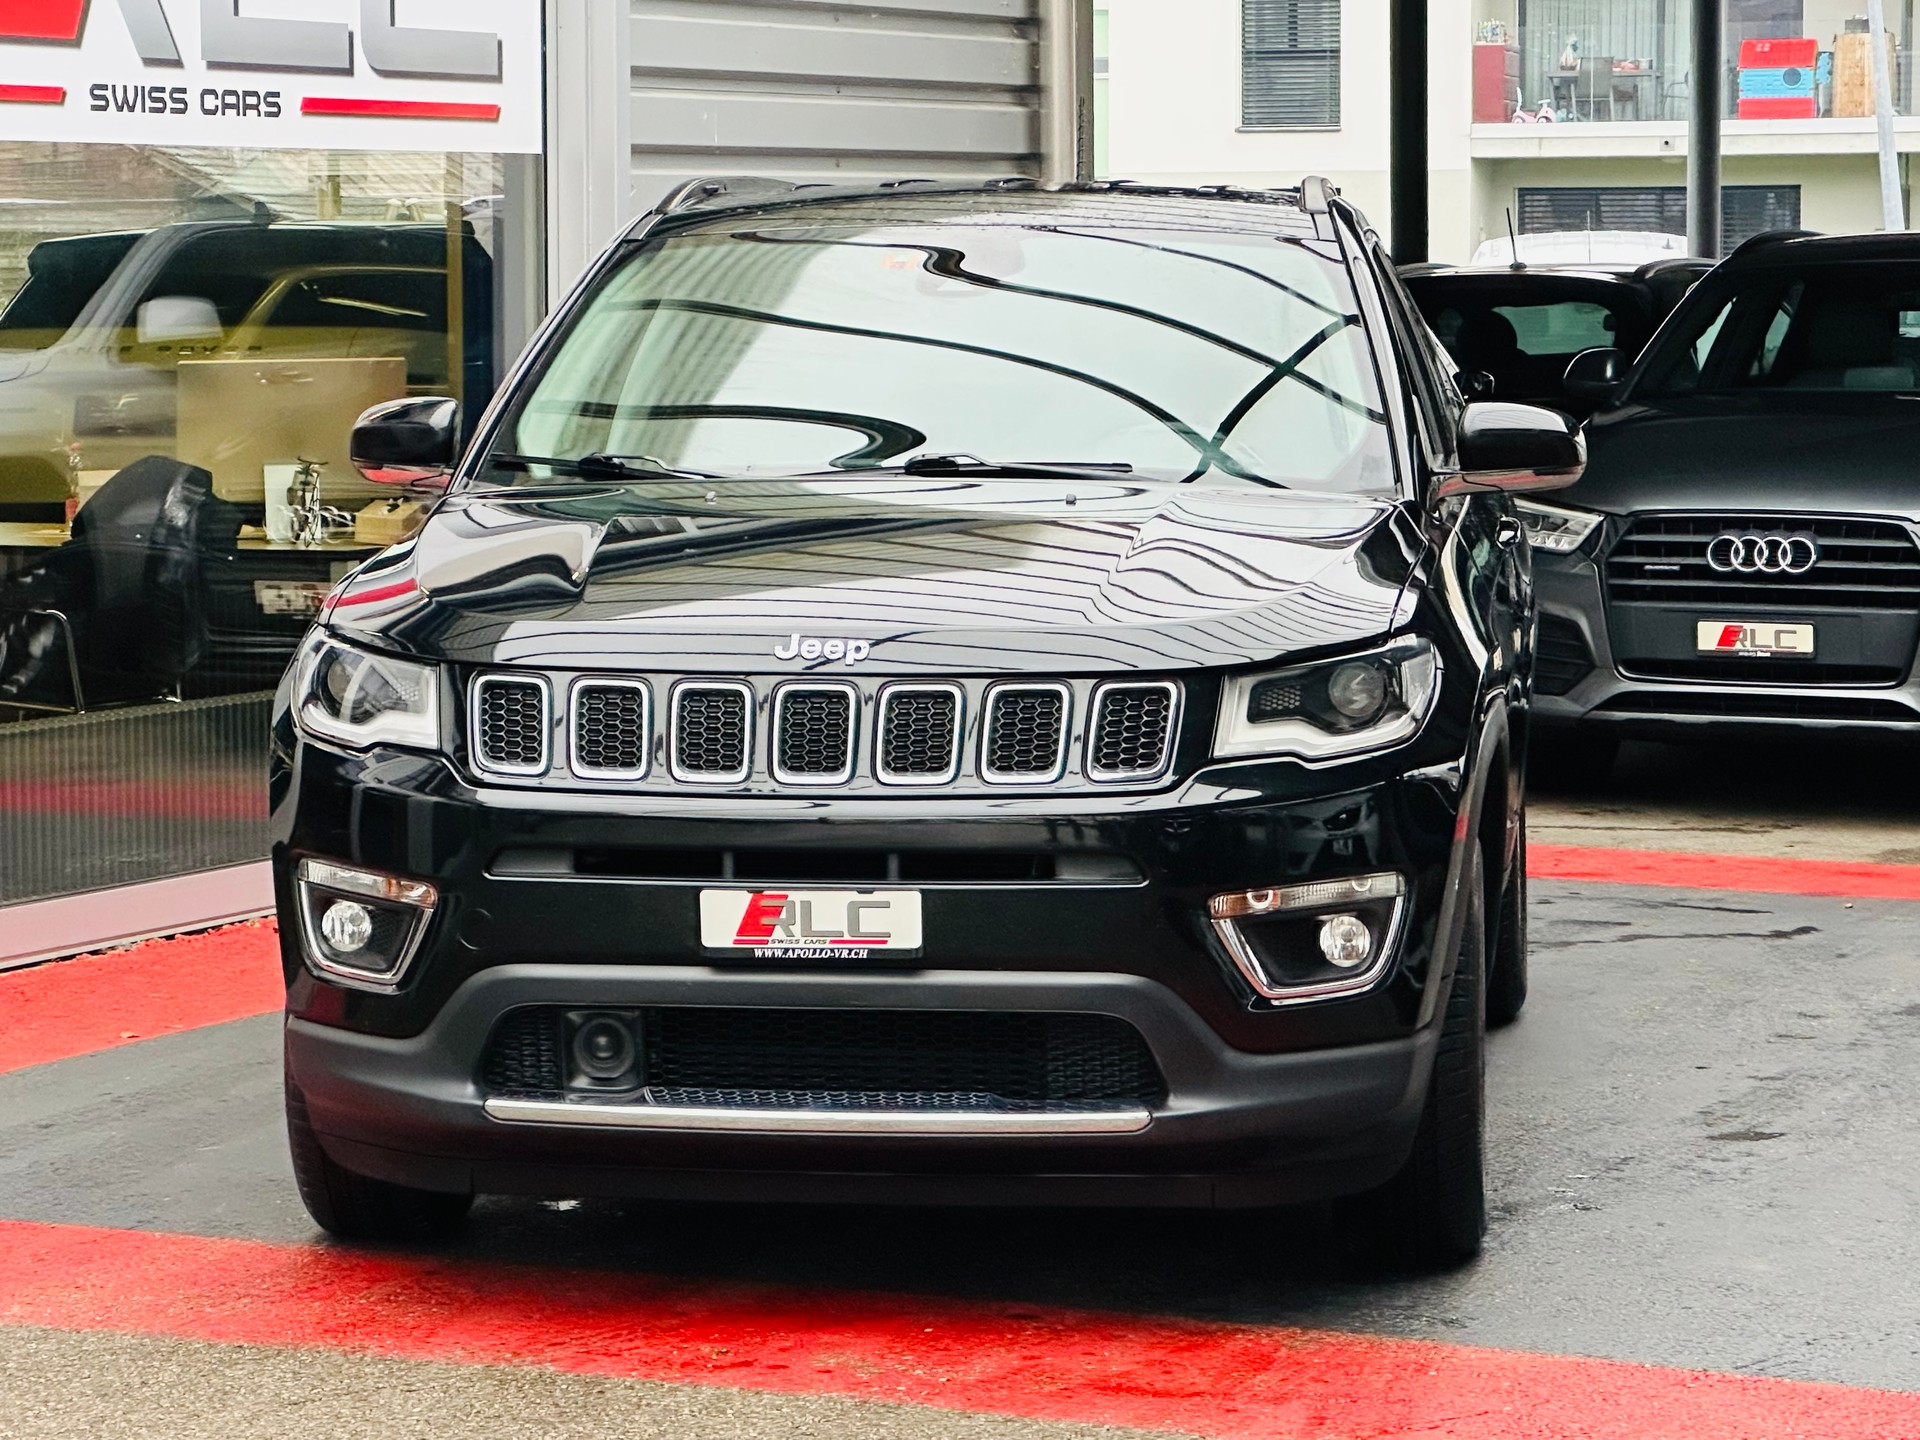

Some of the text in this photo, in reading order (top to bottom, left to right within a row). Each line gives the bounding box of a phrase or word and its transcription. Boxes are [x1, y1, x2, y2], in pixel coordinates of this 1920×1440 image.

[89, 83, 281, 118] SWISS CARS
[774, 633, 870, 666] Jeep
[1728, 628, 1797, 650] RLC
[758, 899, 891, 938] RLC
[753, 948, 868, 959] WWW.APOLLO-VR.CH
